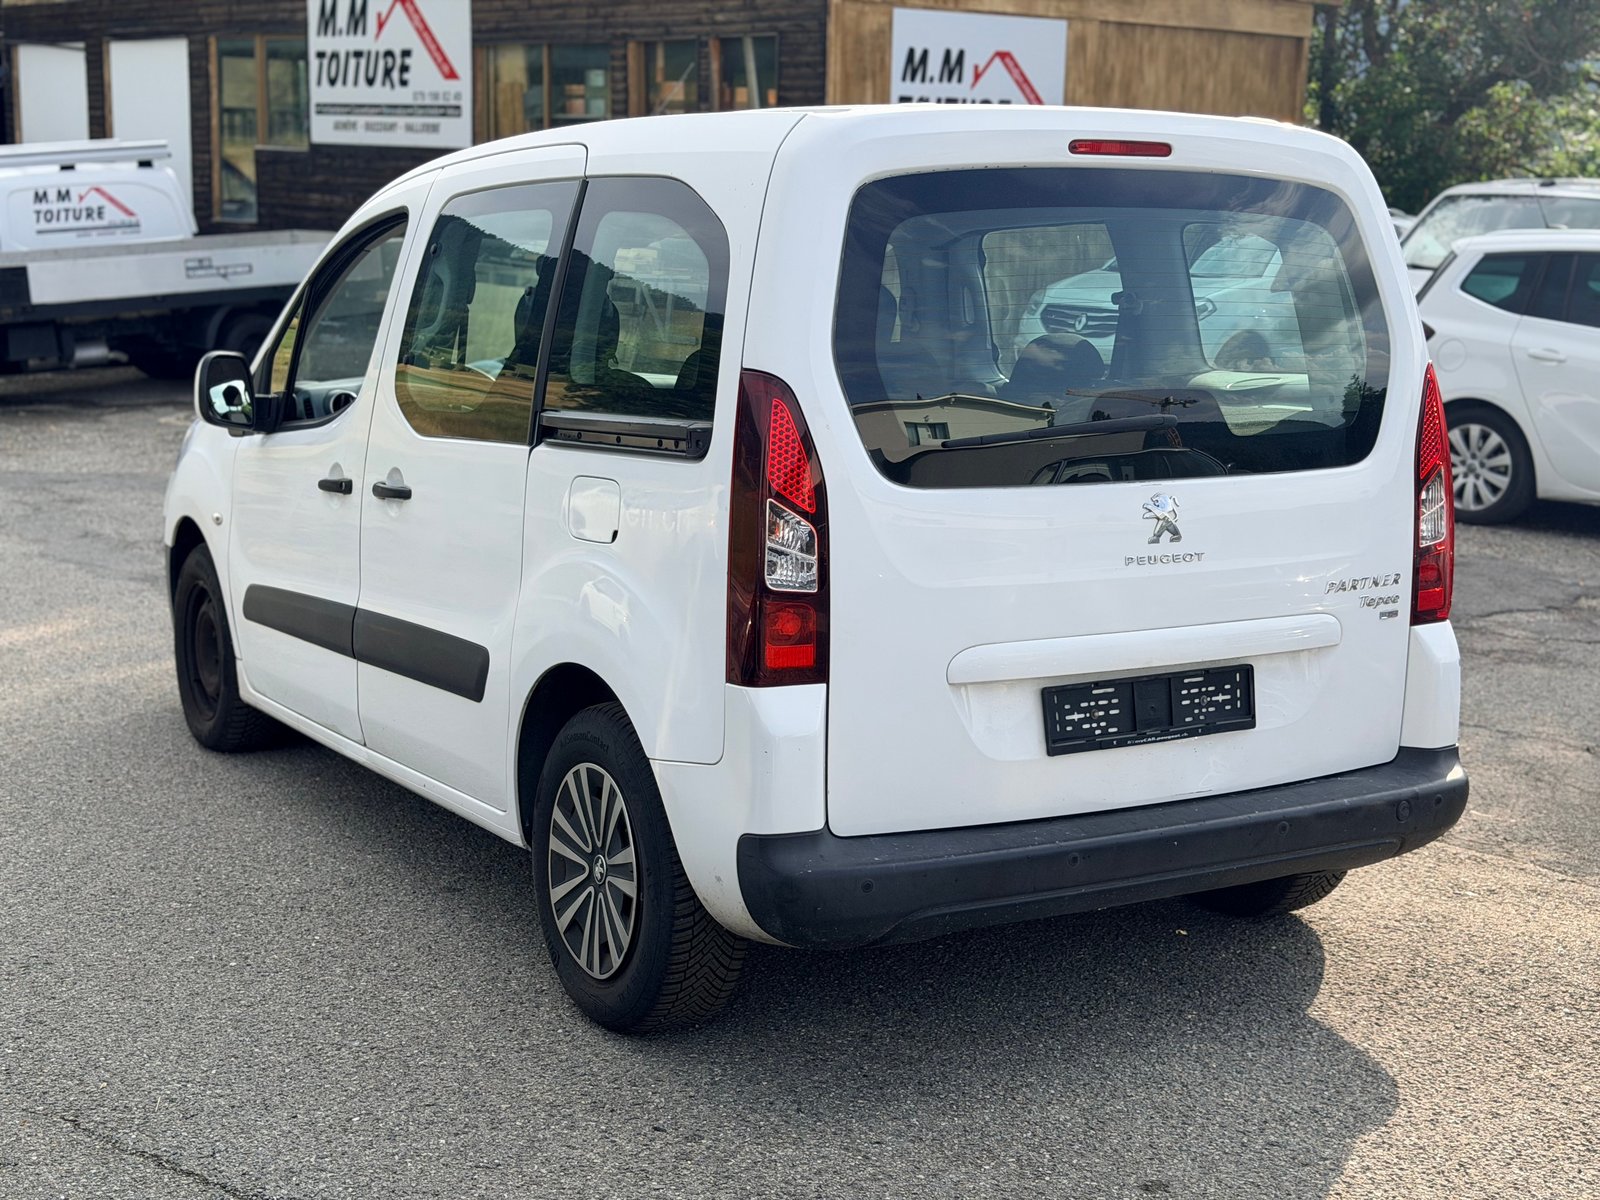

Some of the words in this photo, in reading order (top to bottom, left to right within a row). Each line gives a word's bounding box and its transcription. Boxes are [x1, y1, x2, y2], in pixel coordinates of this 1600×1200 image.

[317, 0, 368, 37] M.M
[316, 49, 412, 90] TOITURE
[902, 47, 965, 84] M.M
[34, 188, 71, 204] M.M
[34, 205, 106, 224] TOITURE
[1125, 552, 1205, 566] PEUGEOT
[1324, 573, 1401, 594] PARTNER
[1359, 595, 1399, 609] Tepee
